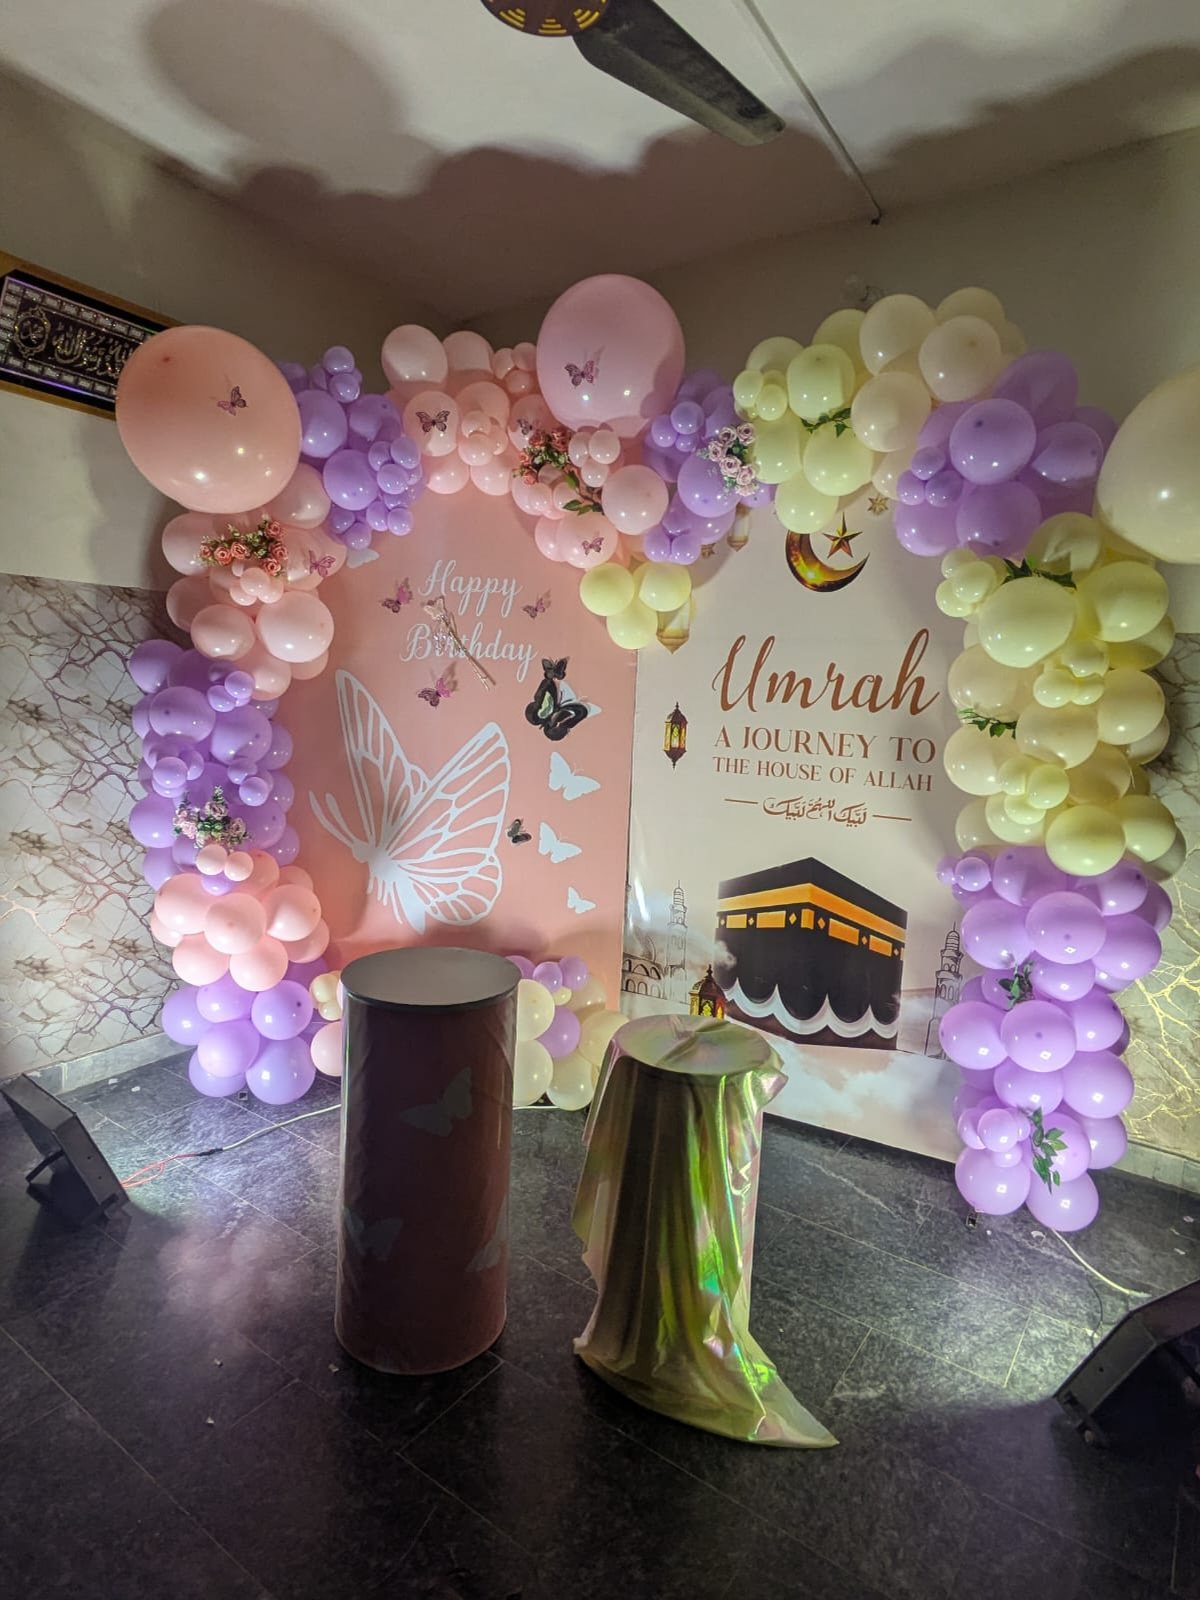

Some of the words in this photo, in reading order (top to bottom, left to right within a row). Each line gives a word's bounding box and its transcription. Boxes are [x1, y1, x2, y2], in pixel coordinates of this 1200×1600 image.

[418, 559, 522, 618] Happy
[711, 628, 941, 716] Umrah
[714, 724, 732, 748] A
[742, 726, 878, 759] JOURNEY
[888, 736, 937, 764] TO
[712, 756, 750, 775] THE
[757, 760, 822, 782] HOUSE
[829, 766, 857, 784] OF
[863, 771, 933, 792] ALLAH
